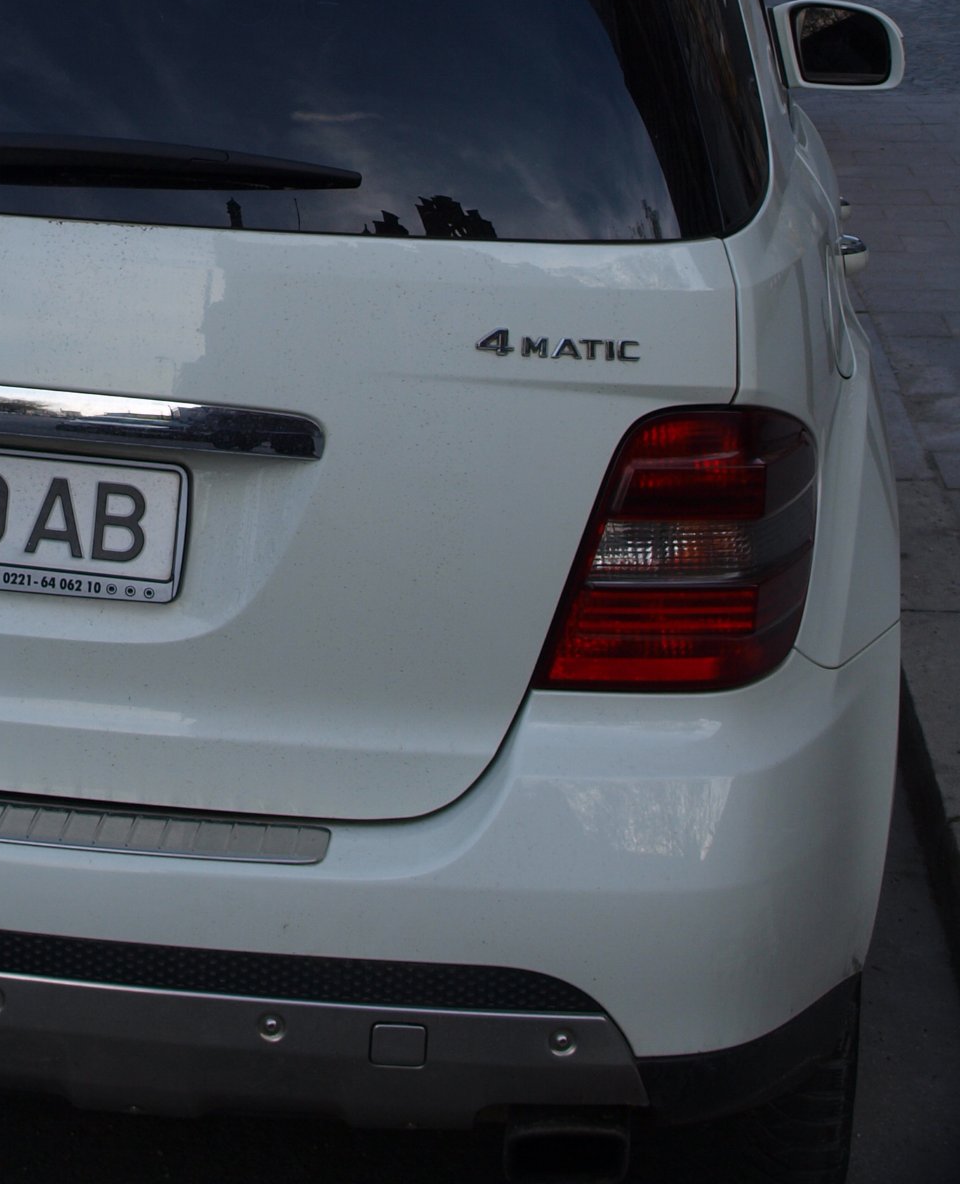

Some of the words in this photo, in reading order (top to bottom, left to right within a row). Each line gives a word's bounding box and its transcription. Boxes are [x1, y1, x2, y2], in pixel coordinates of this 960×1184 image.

[24, 477, 146, 563] AB
[59, 578, 82, 592] 062
[87, 581, 102, 594] 10
